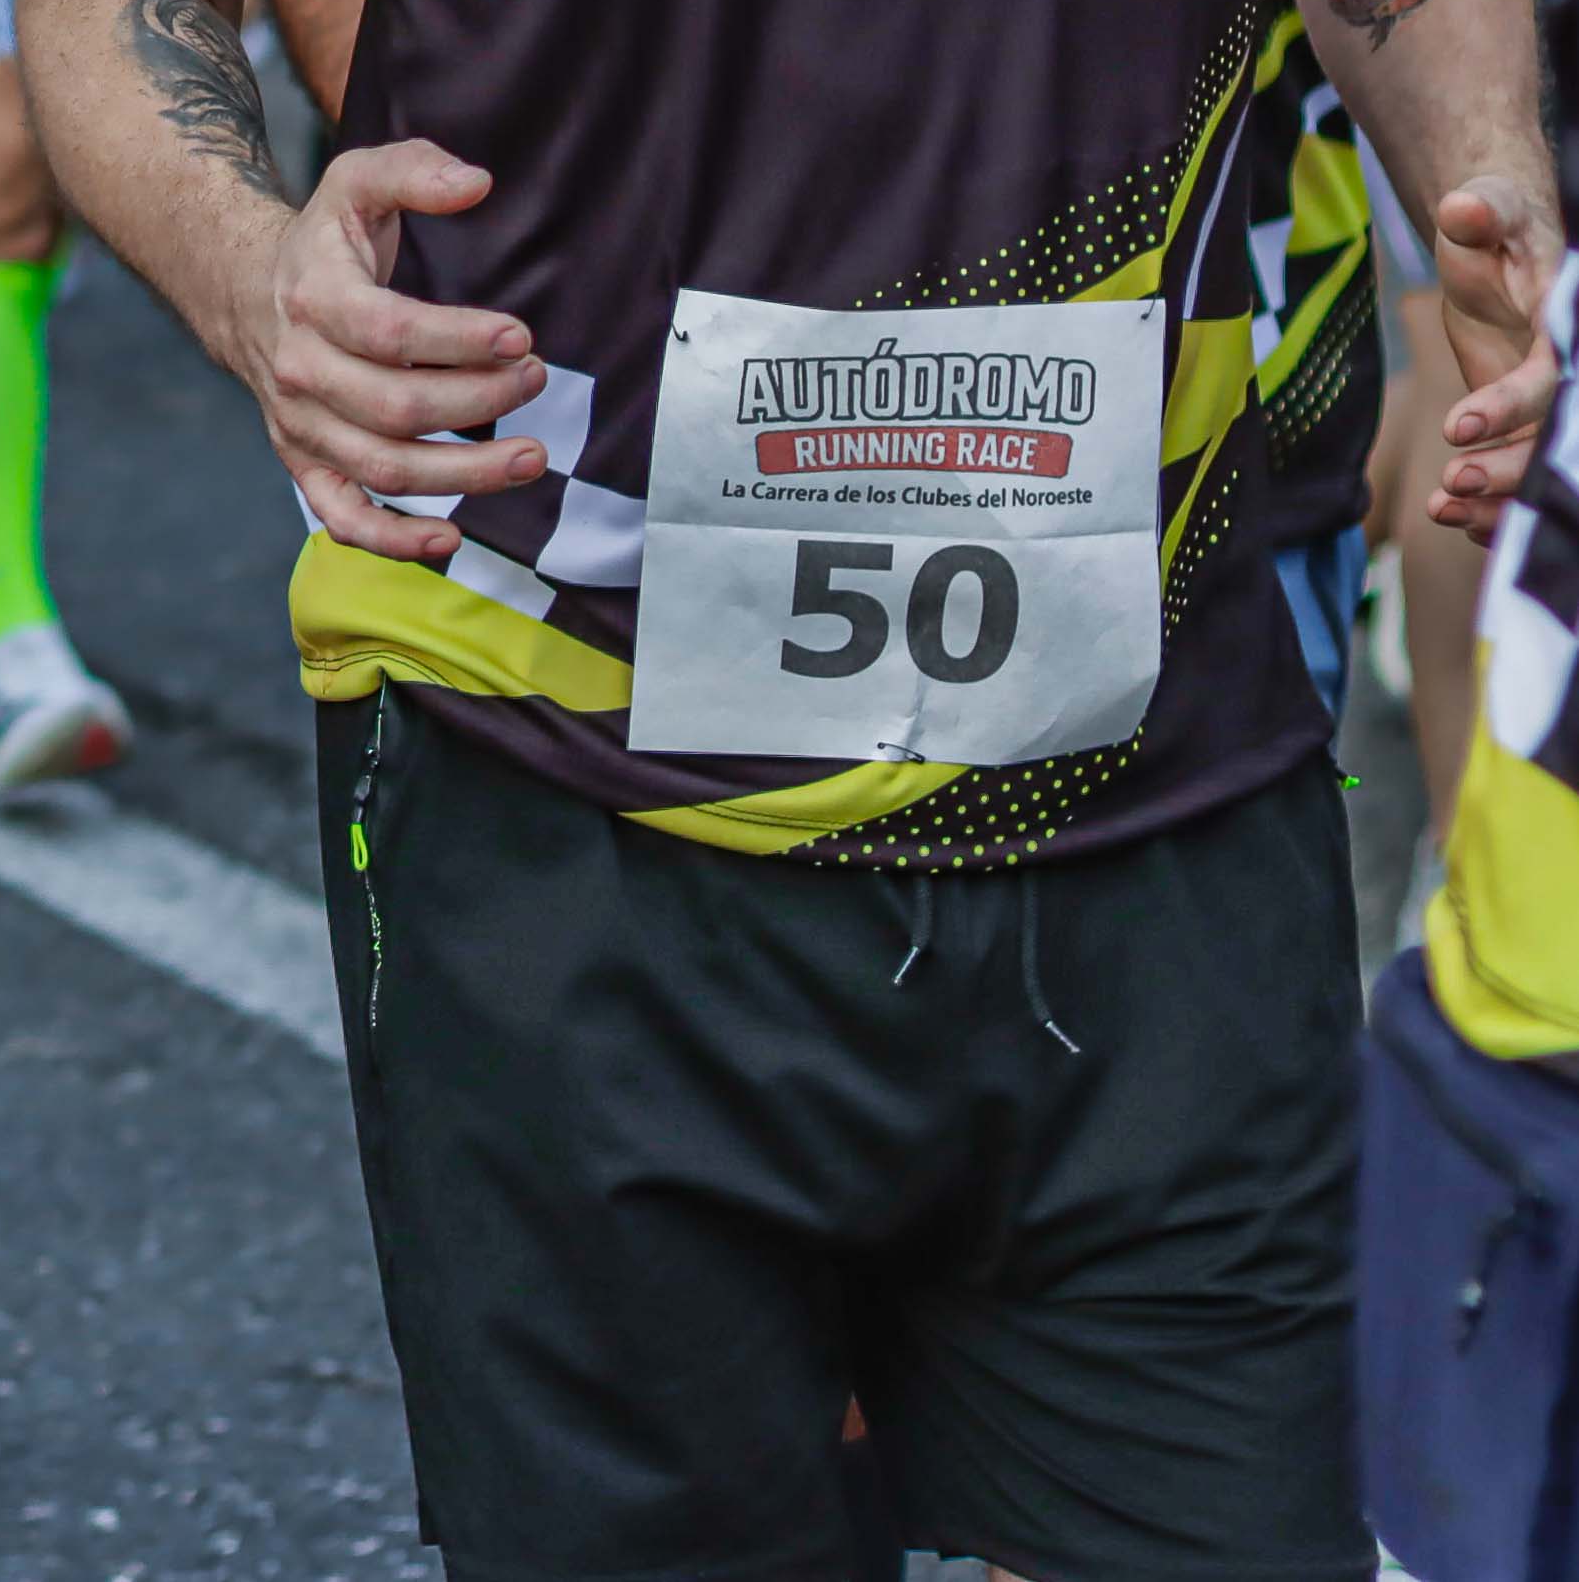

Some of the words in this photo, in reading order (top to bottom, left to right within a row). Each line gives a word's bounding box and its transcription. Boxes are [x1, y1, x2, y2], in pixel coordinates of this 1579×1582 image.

[737, 338, 1096, 424] AUTÓDROMO
[794, 433, 946, 468] RUNNING
[957, 433, 1037, 470] RACE
[722, 479, 746, 498] La
[751, 482, 828, 503] Carrera
[834, 484, 861, 504] de
[866, 484, 896, 505] los
[902, 486, 972, 508] Clubes
[977, 486, 1006, 508] del
[1011, 487, 1093, 506] Noroeste
[780, 538, 1020, 685] 50
